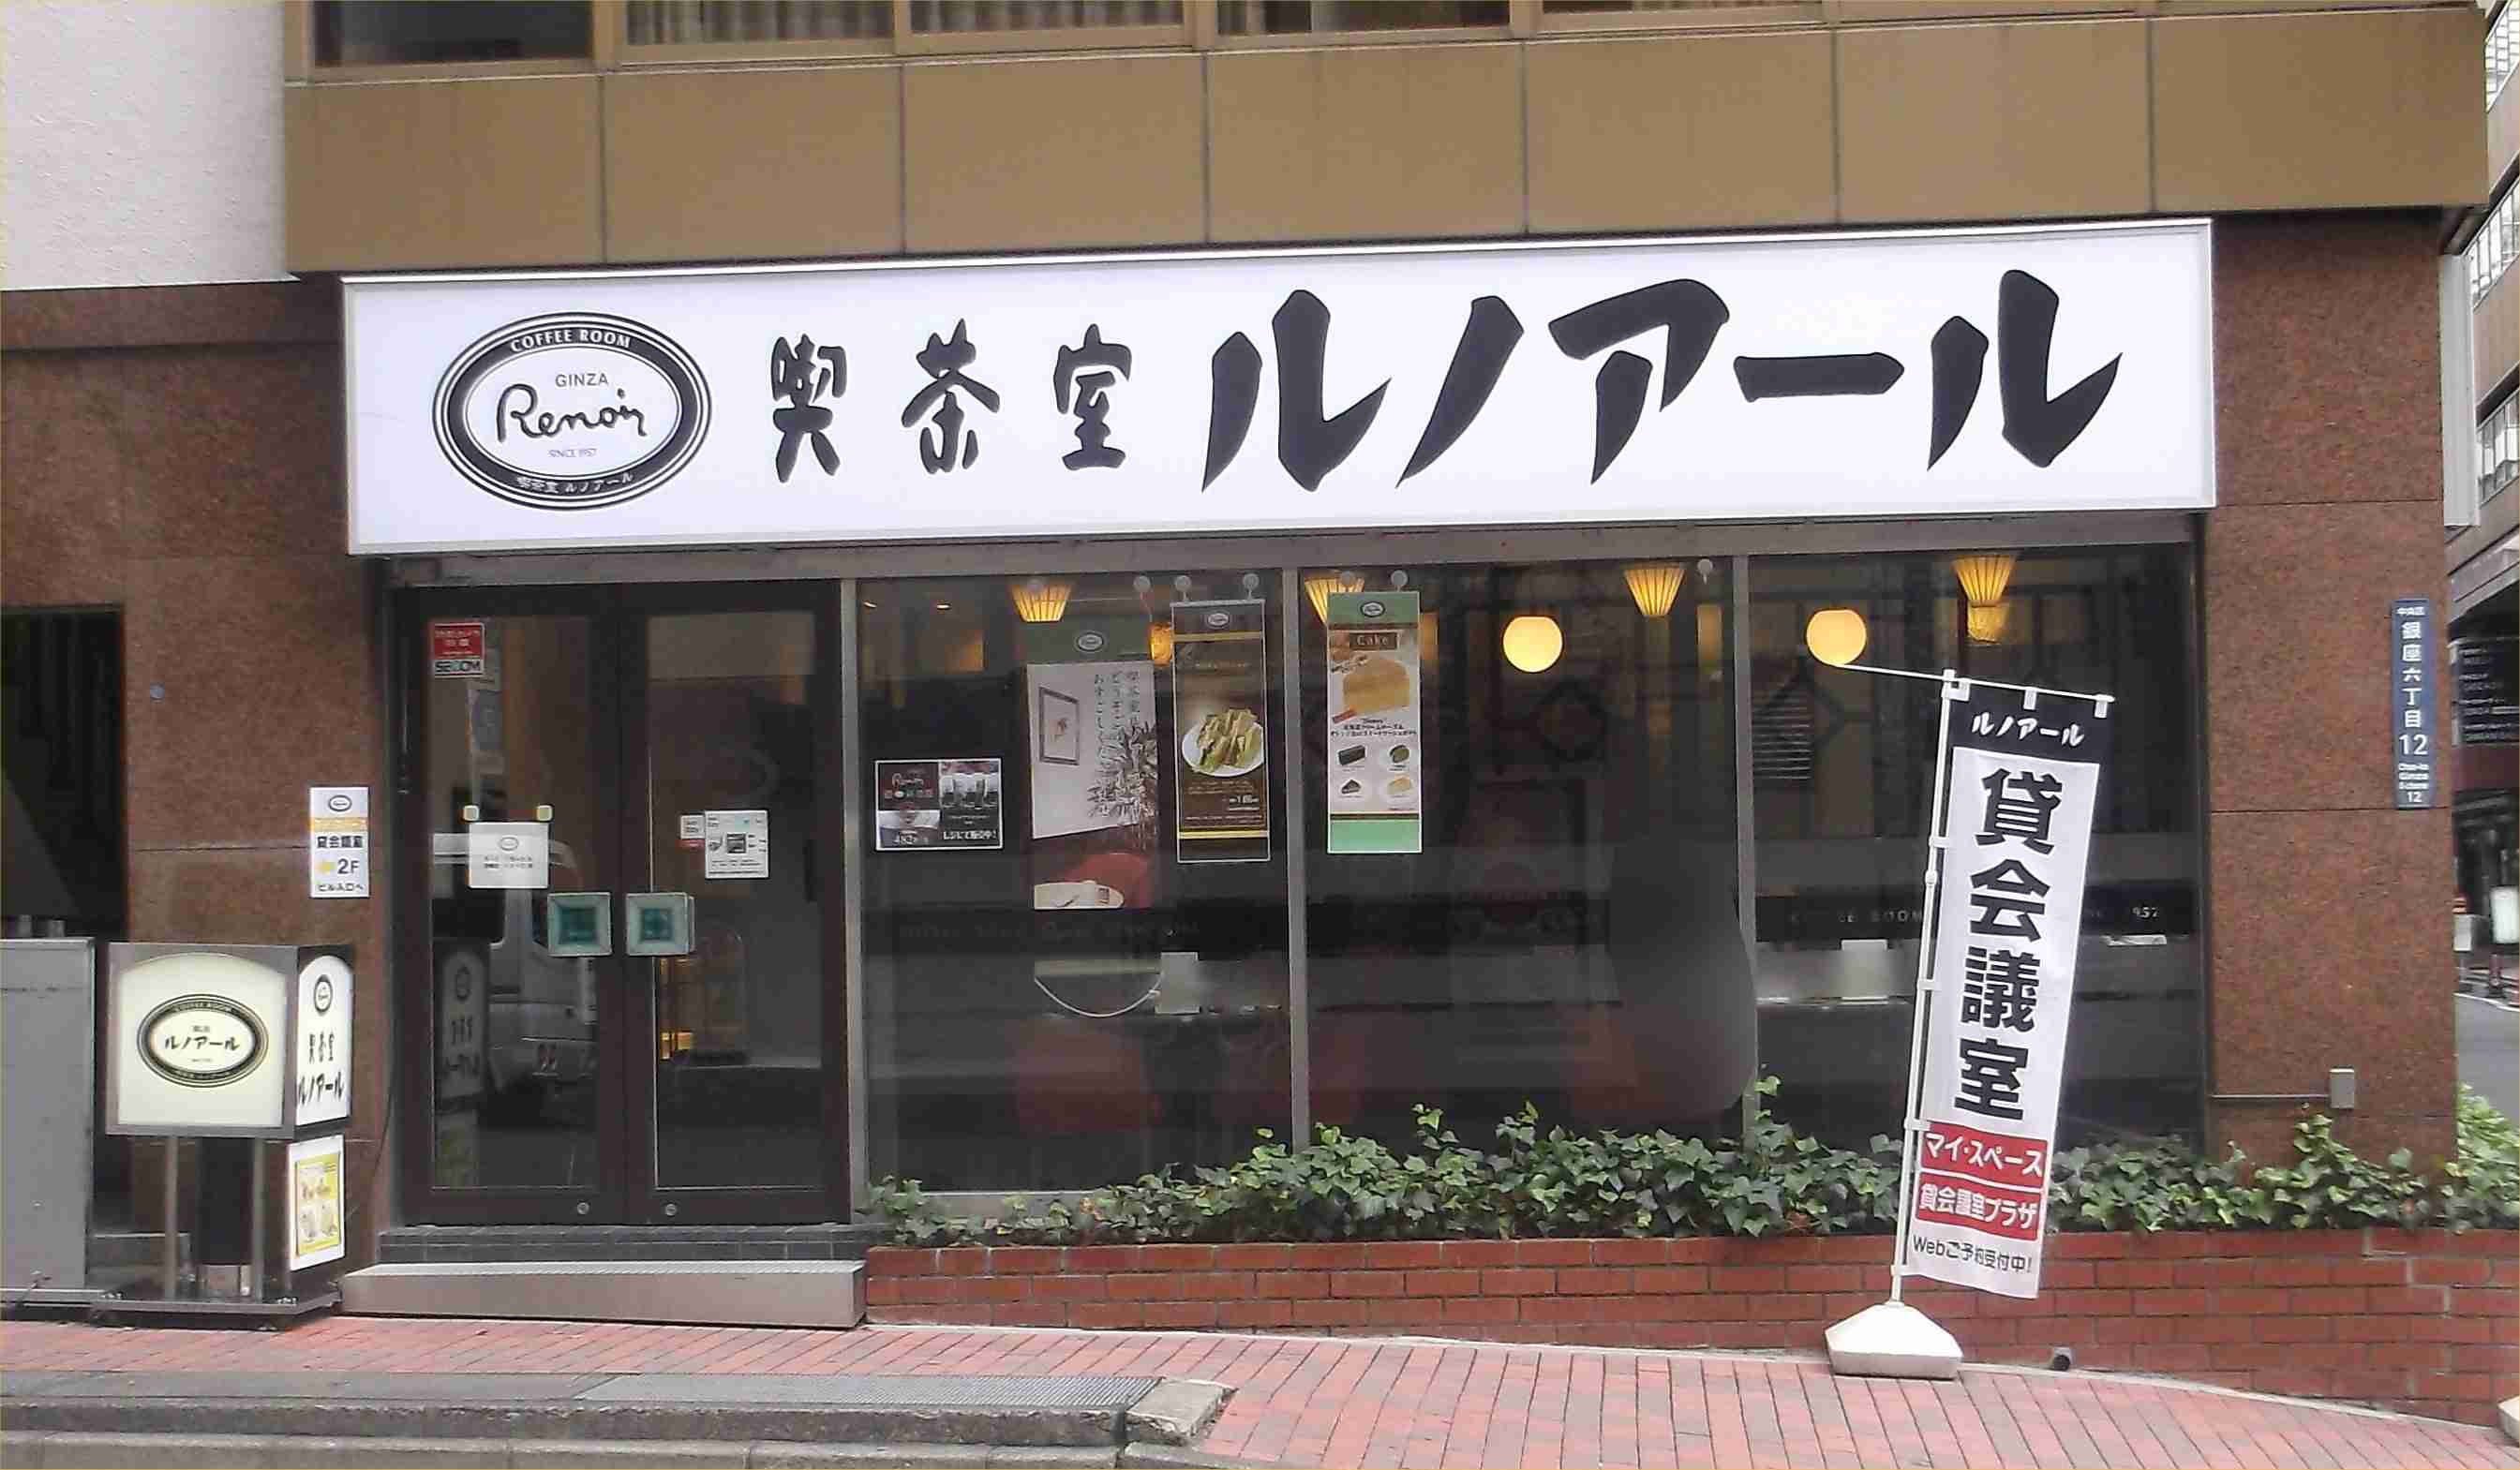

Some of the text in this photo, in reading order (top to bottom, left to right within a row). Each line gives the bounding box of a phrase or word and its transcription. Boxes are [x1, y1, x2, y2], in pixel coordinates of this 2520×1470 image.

[511, 329, 631, 352] COFFEE ROOM
[555, 373, 609, 388] GINZA
[771, 269, 2123, 492] 喫茶室 ルノアール
[2401, 621, 2423, 728] 銀座六丁目
[1971, 710, 2085, 748] ルノアール
[2398, 734, 2428, 755] 12
[2407, 792, 2423, 803] 12
[337, 858, 359, 874] 2F
[1953, 766, 2064, 1121] 貸会議室
[164, 1034, 241, 1051] ルノアール
